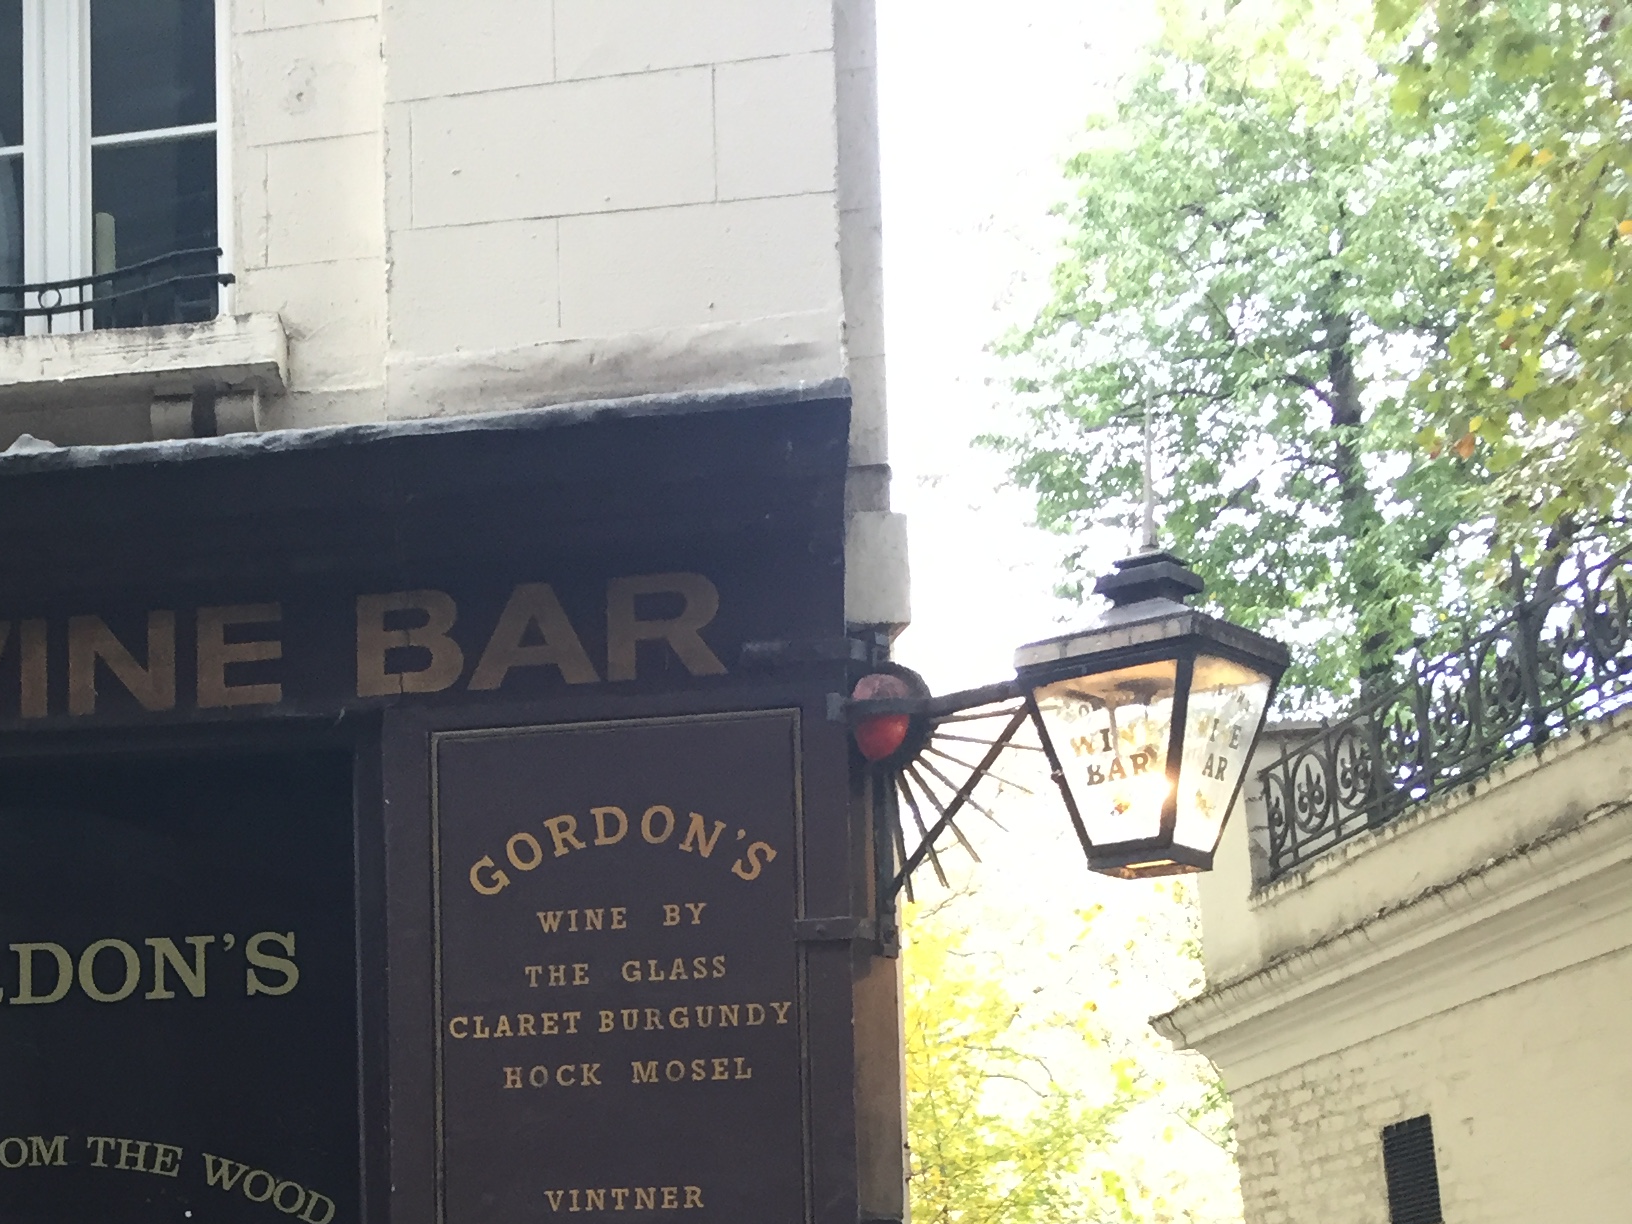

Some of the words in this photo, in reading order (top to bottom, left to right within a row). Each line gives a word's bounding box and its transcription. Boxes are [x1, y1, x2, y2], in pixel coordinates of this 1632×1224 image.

[356, 571, 728, 698] BAR
[1086, 752, 1149, 786] BAR
[469, 805, 777, 896] GORDON'S
[536, 906, 628, 934] WINE
[662, 903, 708, 927] BY
[525, 963, 590, 988] THE
[620, 955, 728, 983] GLASS
[449, 1011, 581, 1039] CLARET
[598, 1001, 792, 1034] BURGUNDY
[503, 1063, 602, 1090] HOCK
[631, 1056, 753, 1085] MOSEL
[86, 1136, 183, 1178] THE
[543, 1185, 705, 1213] VINTNER
